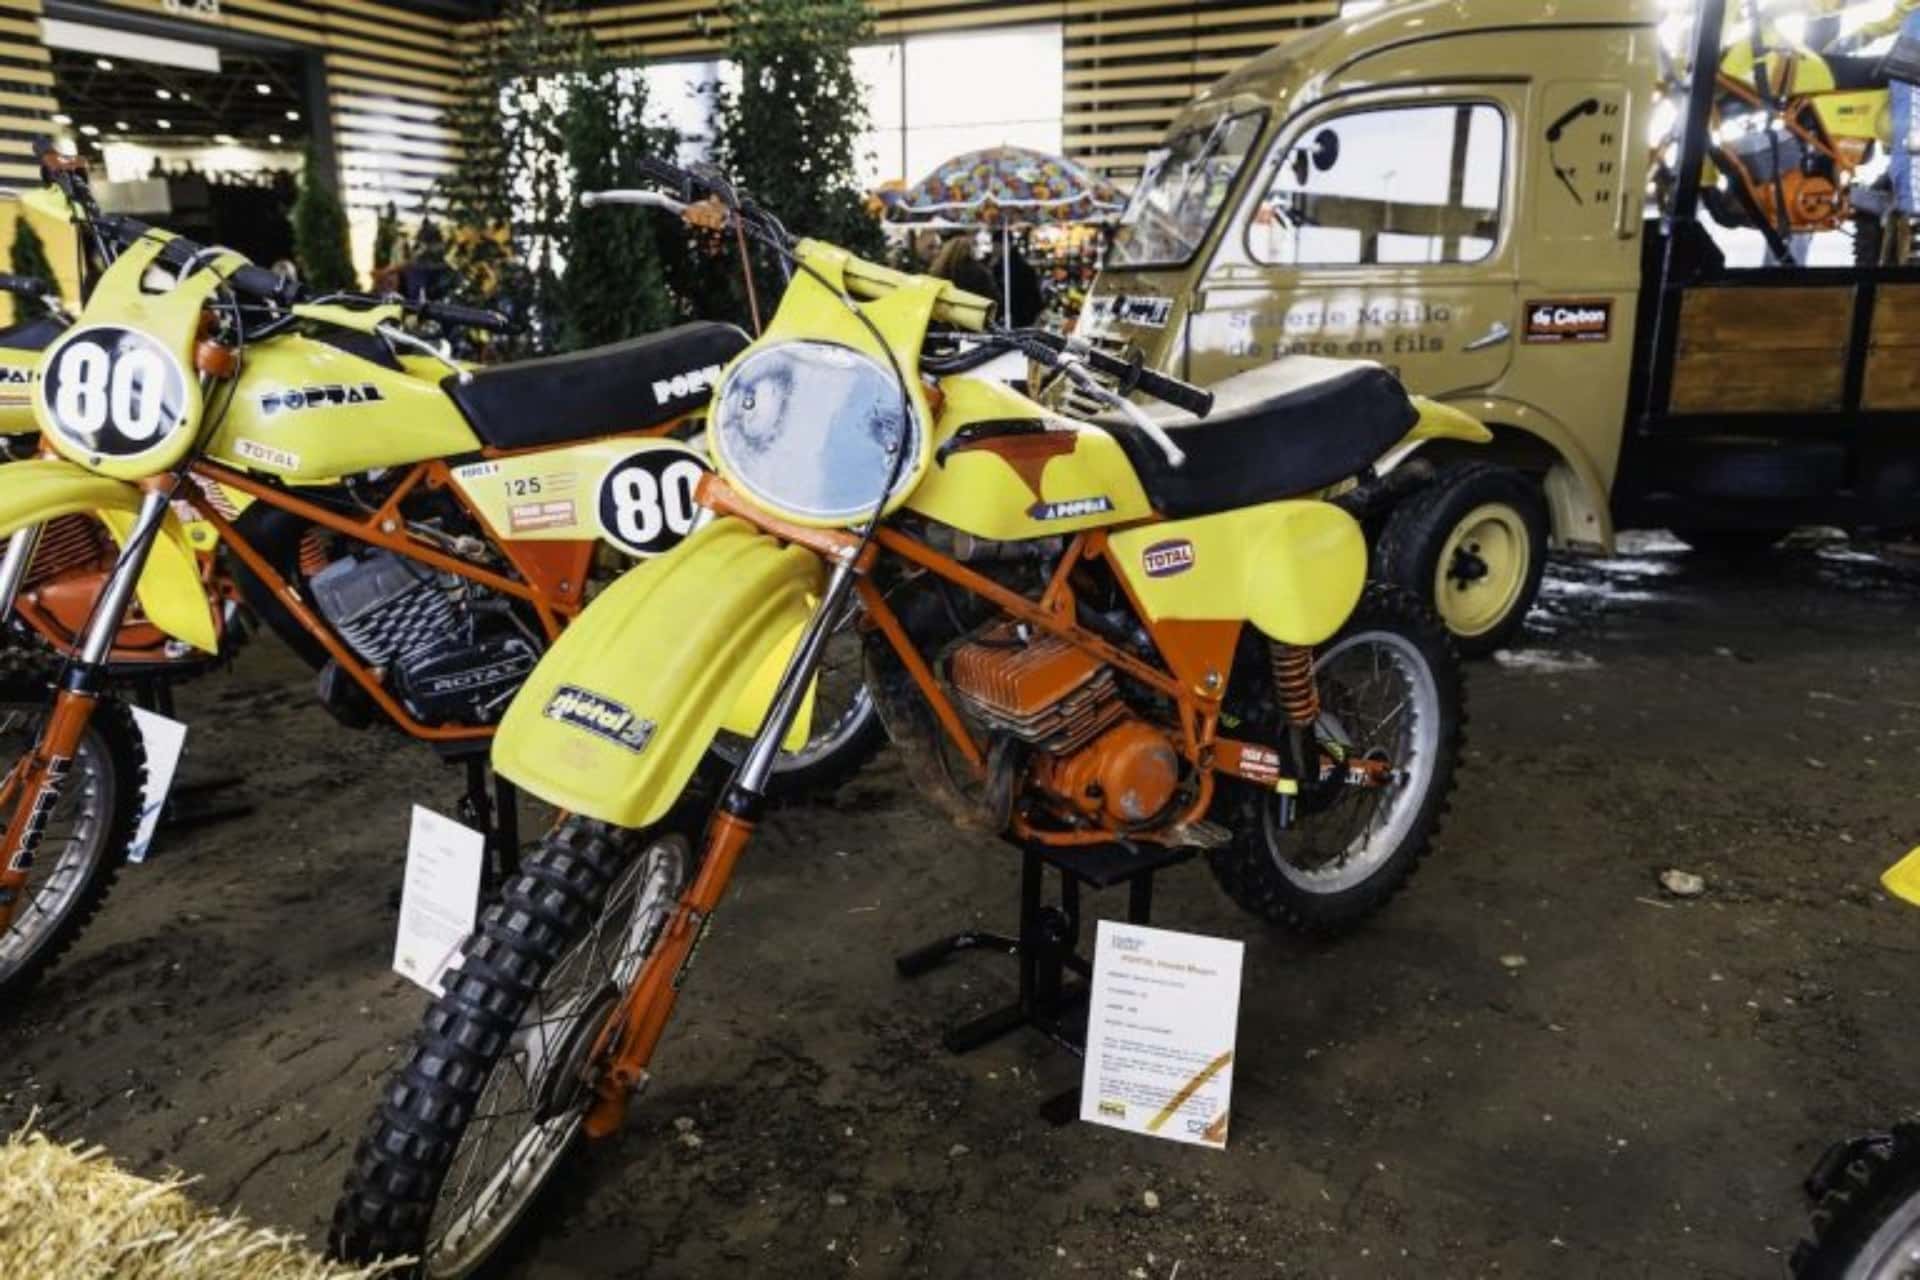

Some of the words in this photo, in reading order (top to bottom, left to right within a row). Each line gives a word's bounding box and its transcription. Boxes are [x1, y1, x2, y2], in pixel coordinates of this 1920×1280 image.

[1344, 338, 1382, 354] en
[1394, 333, 1445, 353] fils
[56, 342, 165, 440] 80
[243, 441, 294, 467] TOTAL
[505, 476, 541, 497] 125
[611, 459, 707, 544] 80
[1146, 546, 1191, 570] TOTAL
